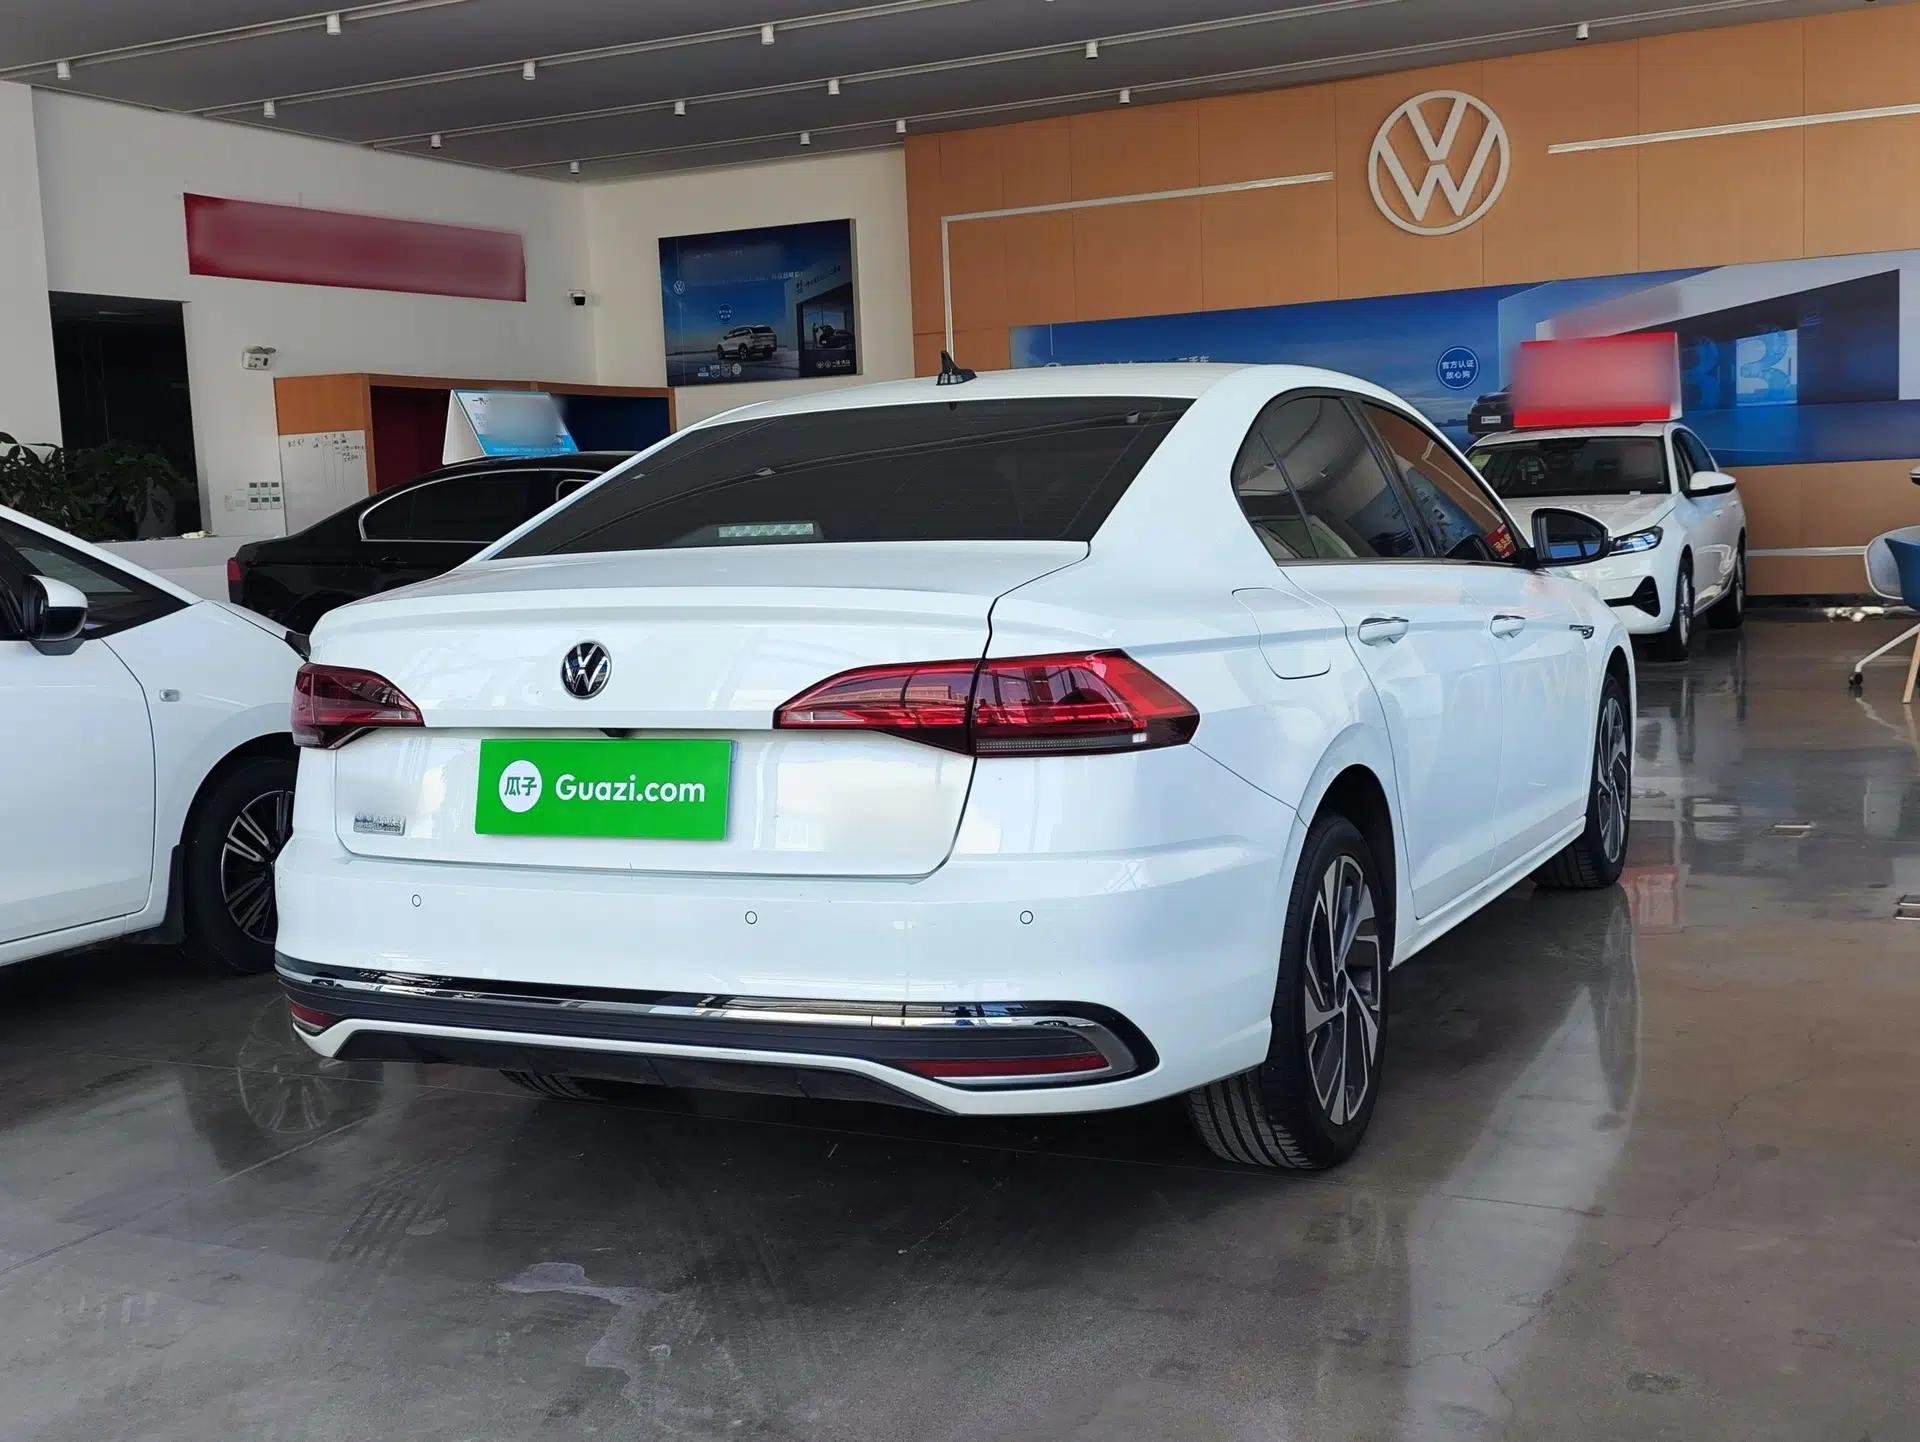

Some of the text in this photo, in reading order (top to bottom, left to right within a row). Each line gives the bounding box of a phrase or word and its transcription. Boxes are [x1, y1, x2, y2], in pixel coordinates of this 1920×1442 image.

[1369, 91, 1509, 235] VW
[1441, 360, 1475, 370] 官方认证
[561, 640, 611, 699] VW
